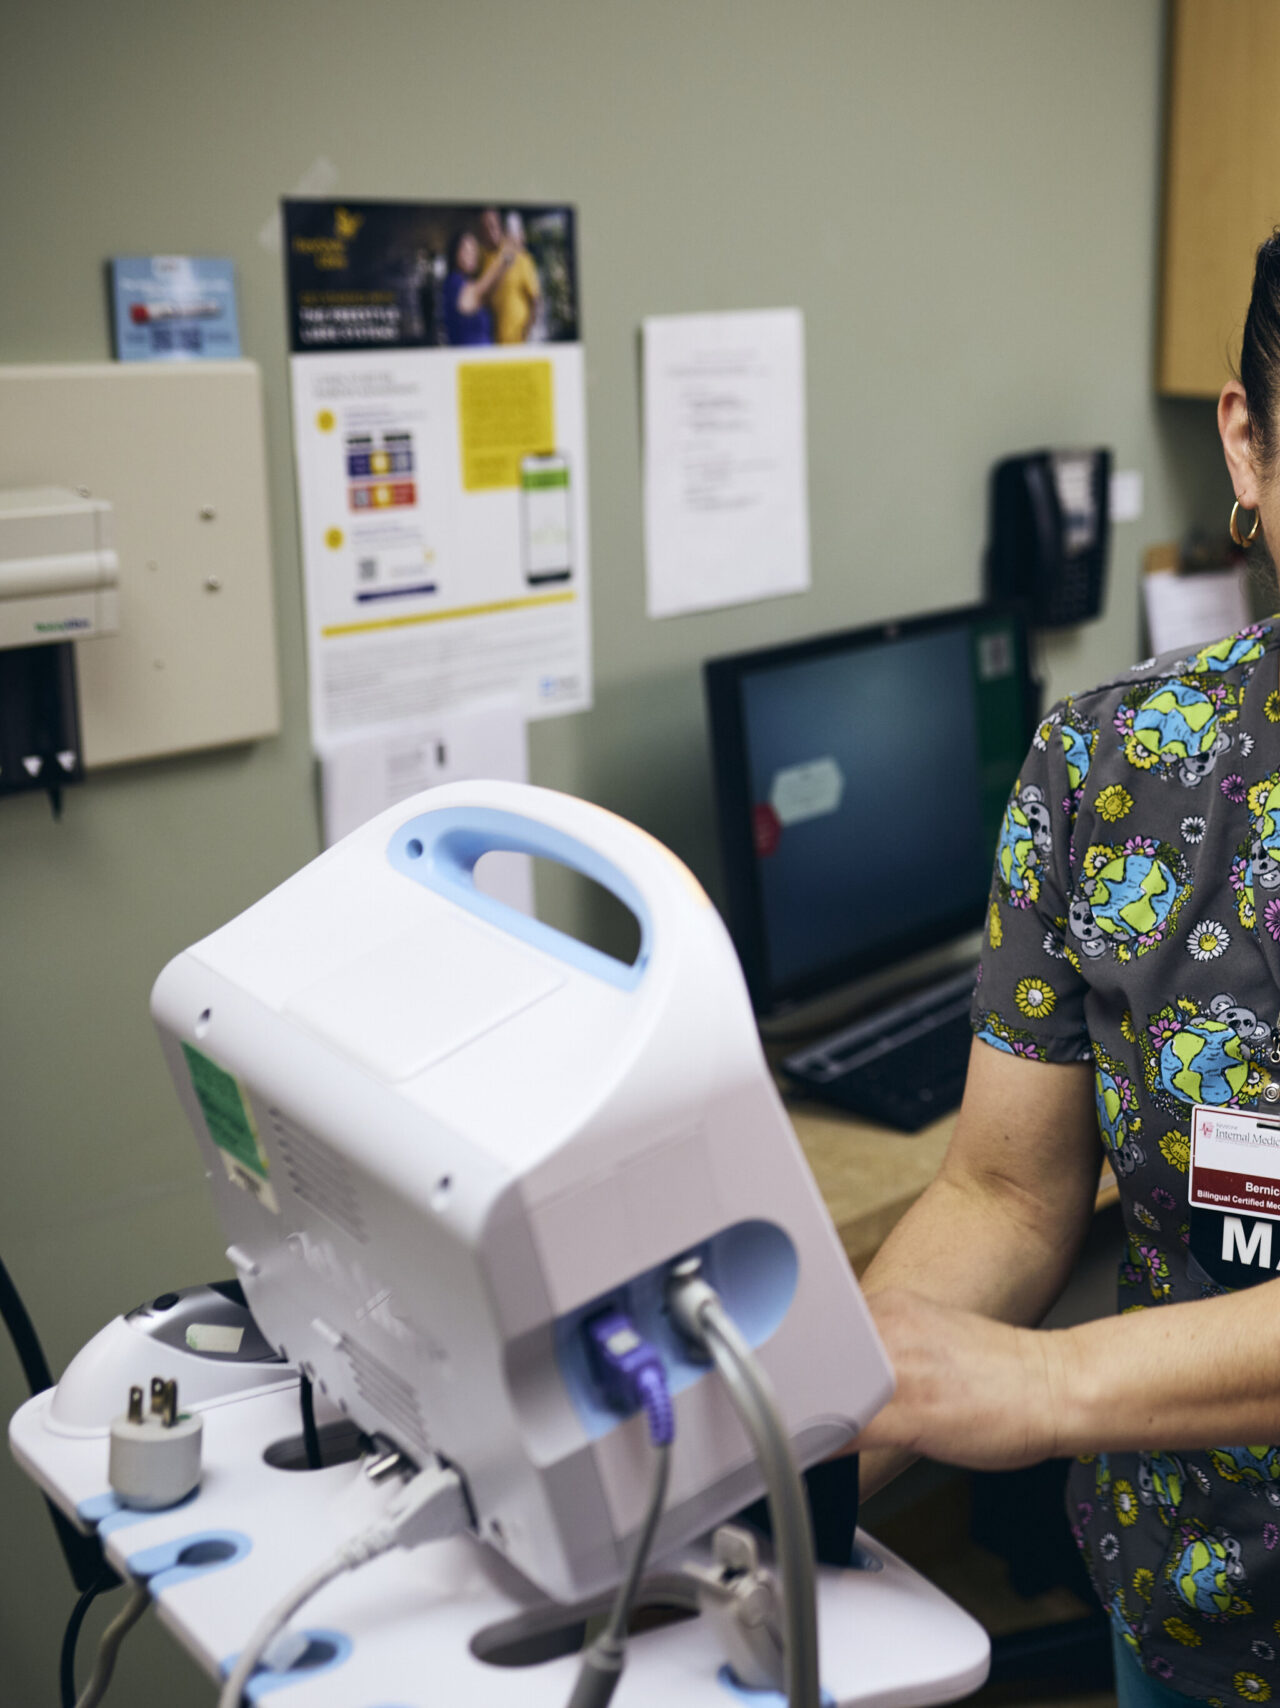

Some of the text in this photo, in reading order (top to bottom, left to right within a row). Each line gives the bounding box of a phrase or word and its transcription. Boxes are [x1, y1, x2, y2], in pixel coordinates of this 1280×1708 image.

[1215, 1128, 1250, 1142] Internal
[1196, 1189, 1231, 1202] Bilingual
[1232, 1194, 1265, 1208] Certified
